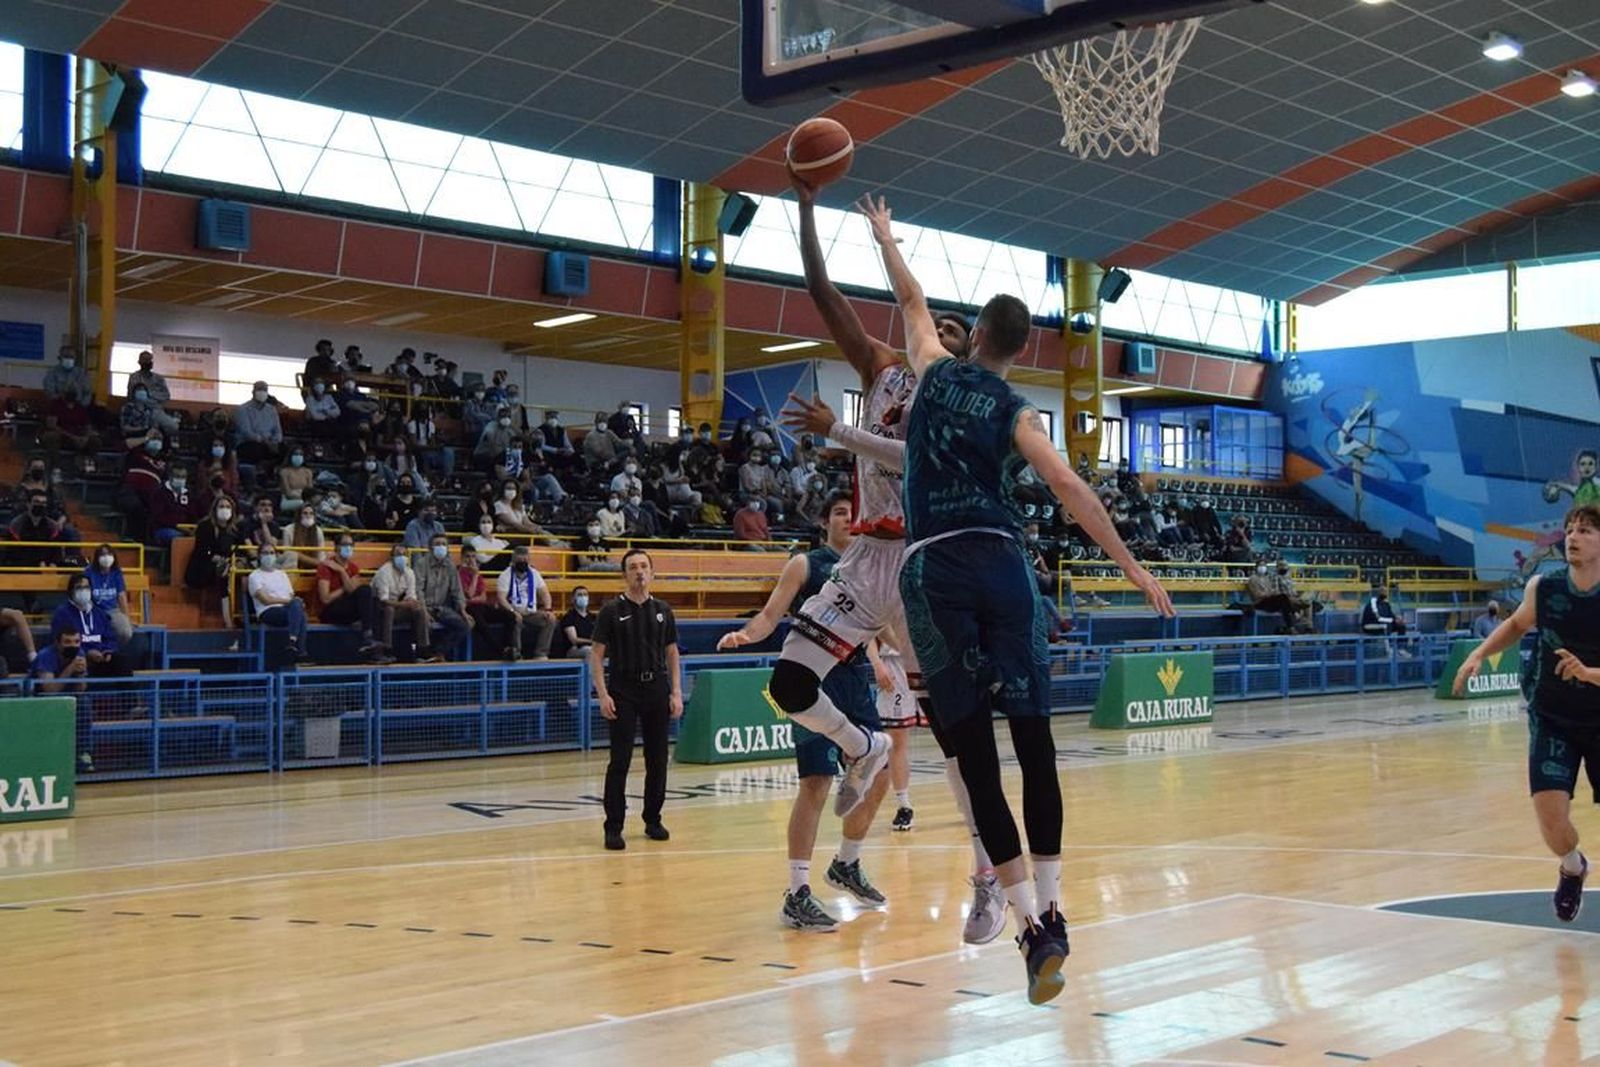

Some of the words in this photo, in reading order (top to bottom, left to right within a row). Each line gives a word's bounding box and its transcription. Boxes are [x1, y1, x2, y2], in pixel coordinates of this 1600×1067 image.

[833, 593, 855, 615] 22
[1468, 674, 1490, 692] CAJA
[1490, 672, 1520, 691] RURAL
[895, 693, 902, 706] 2
[1127, 699, 1162, 723] CAJA
[1163, 696, 1212, 720] RURAL
[714, 725, 769, 754] CAJA
